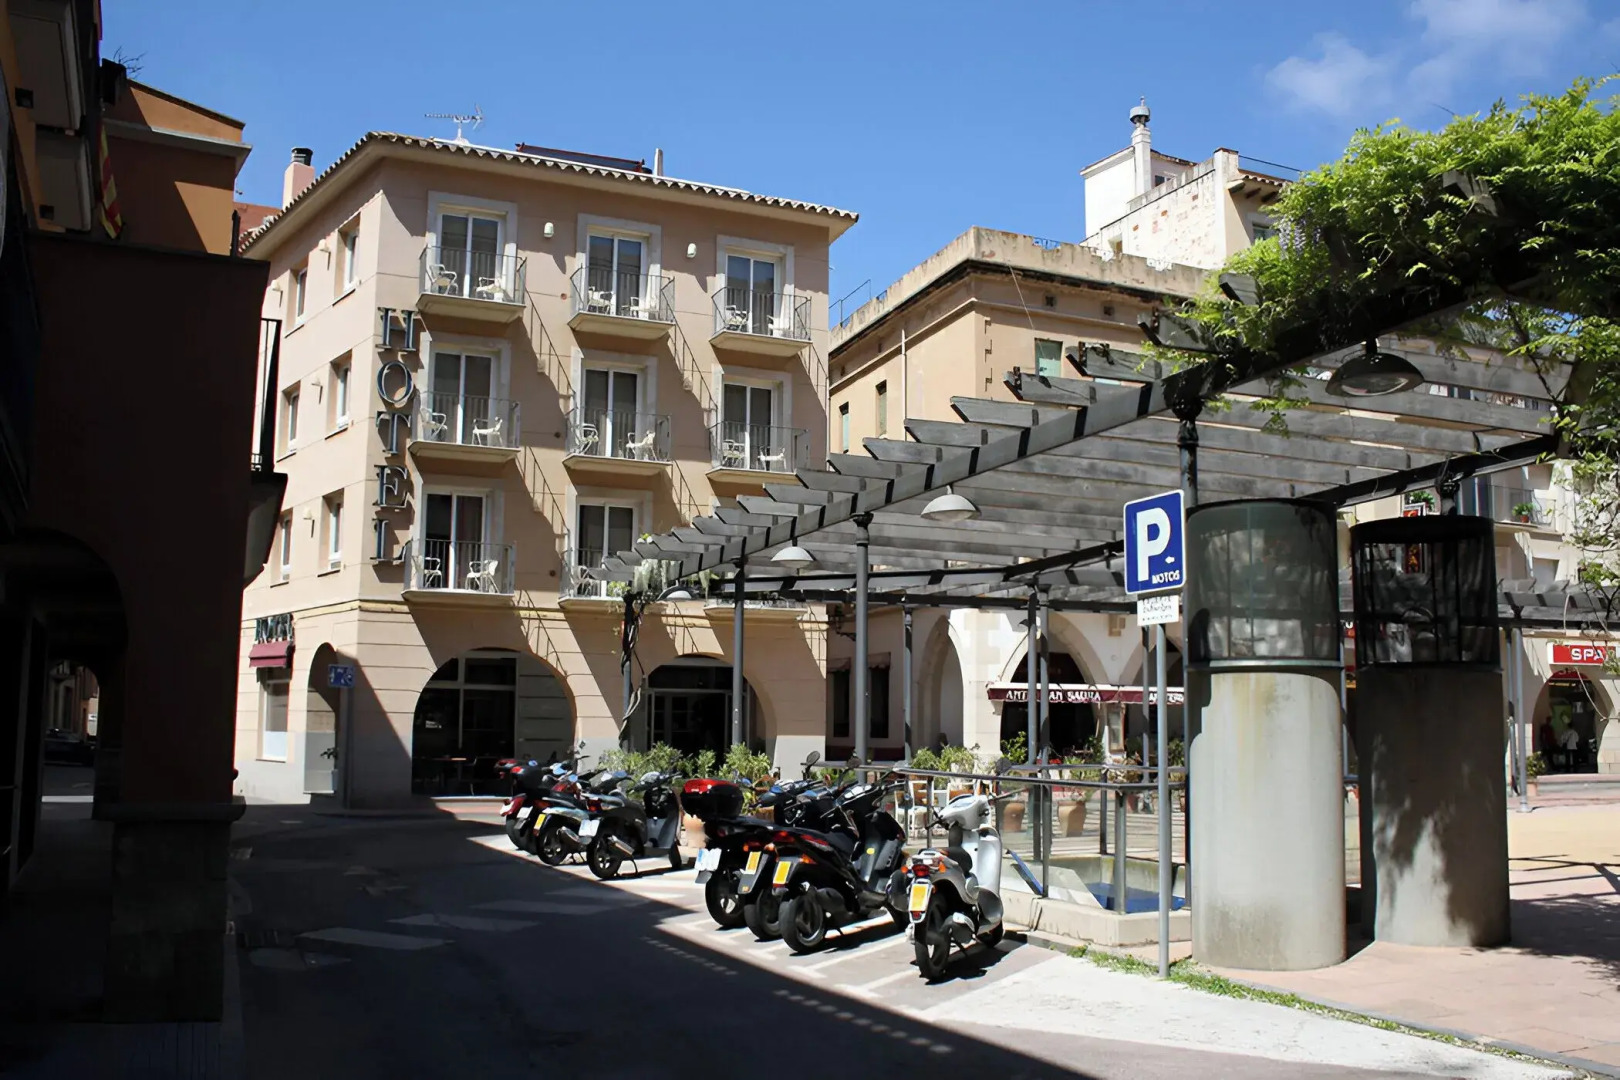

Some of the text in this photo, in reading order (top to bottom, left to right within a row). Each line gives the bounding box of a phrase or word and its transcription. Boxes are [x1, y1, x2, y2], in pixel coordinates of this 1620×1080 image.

[370, 307, 420, 562] HOTEL
[1136, 507, 1171, 582] P
[1151, 570, 1180, 585] MOTOS
[1571, 648, 1605, 661] SPA
